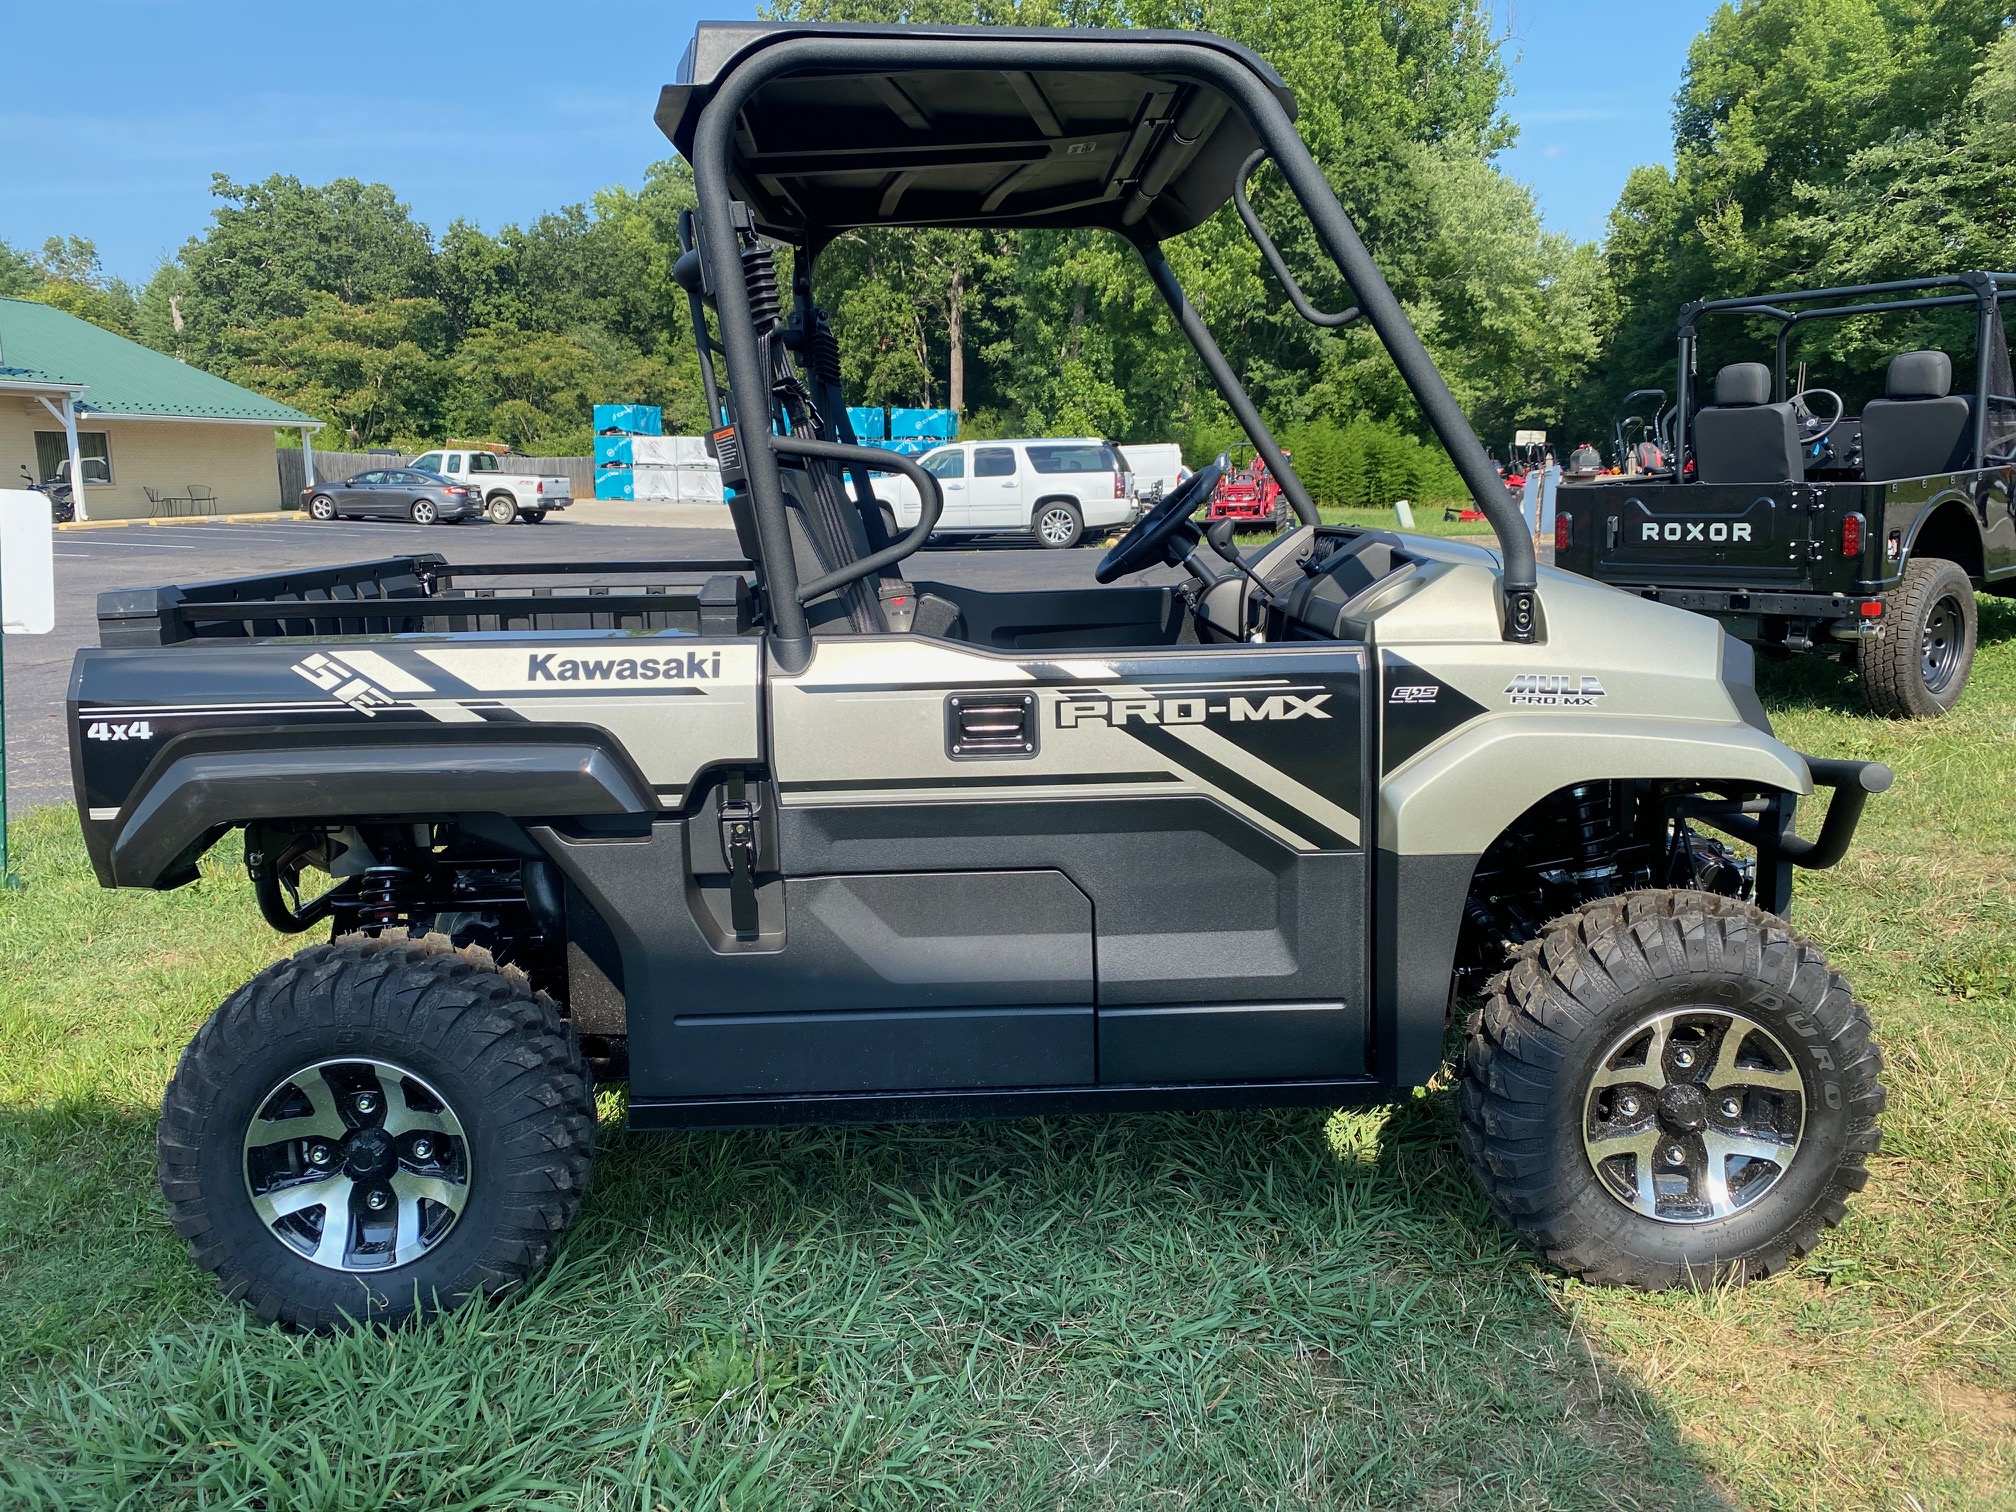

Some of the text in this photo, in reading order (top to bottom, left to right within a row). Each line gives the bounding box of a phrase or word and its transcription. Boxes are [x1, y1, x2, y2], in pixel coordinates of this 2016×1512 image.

[1641, 522, 1752, 542] ROXOR
[527, 651, 721, 681] Kawasaki
[1503, 674, 1607, 696] MULE
[1060, 693, 1334, 727] PRO-MX
[1510, 695, 1598, 707] PRO-MX
[87, 721, 154, 741] 4x4
[1749, 989, 1843, 1110] DURO
